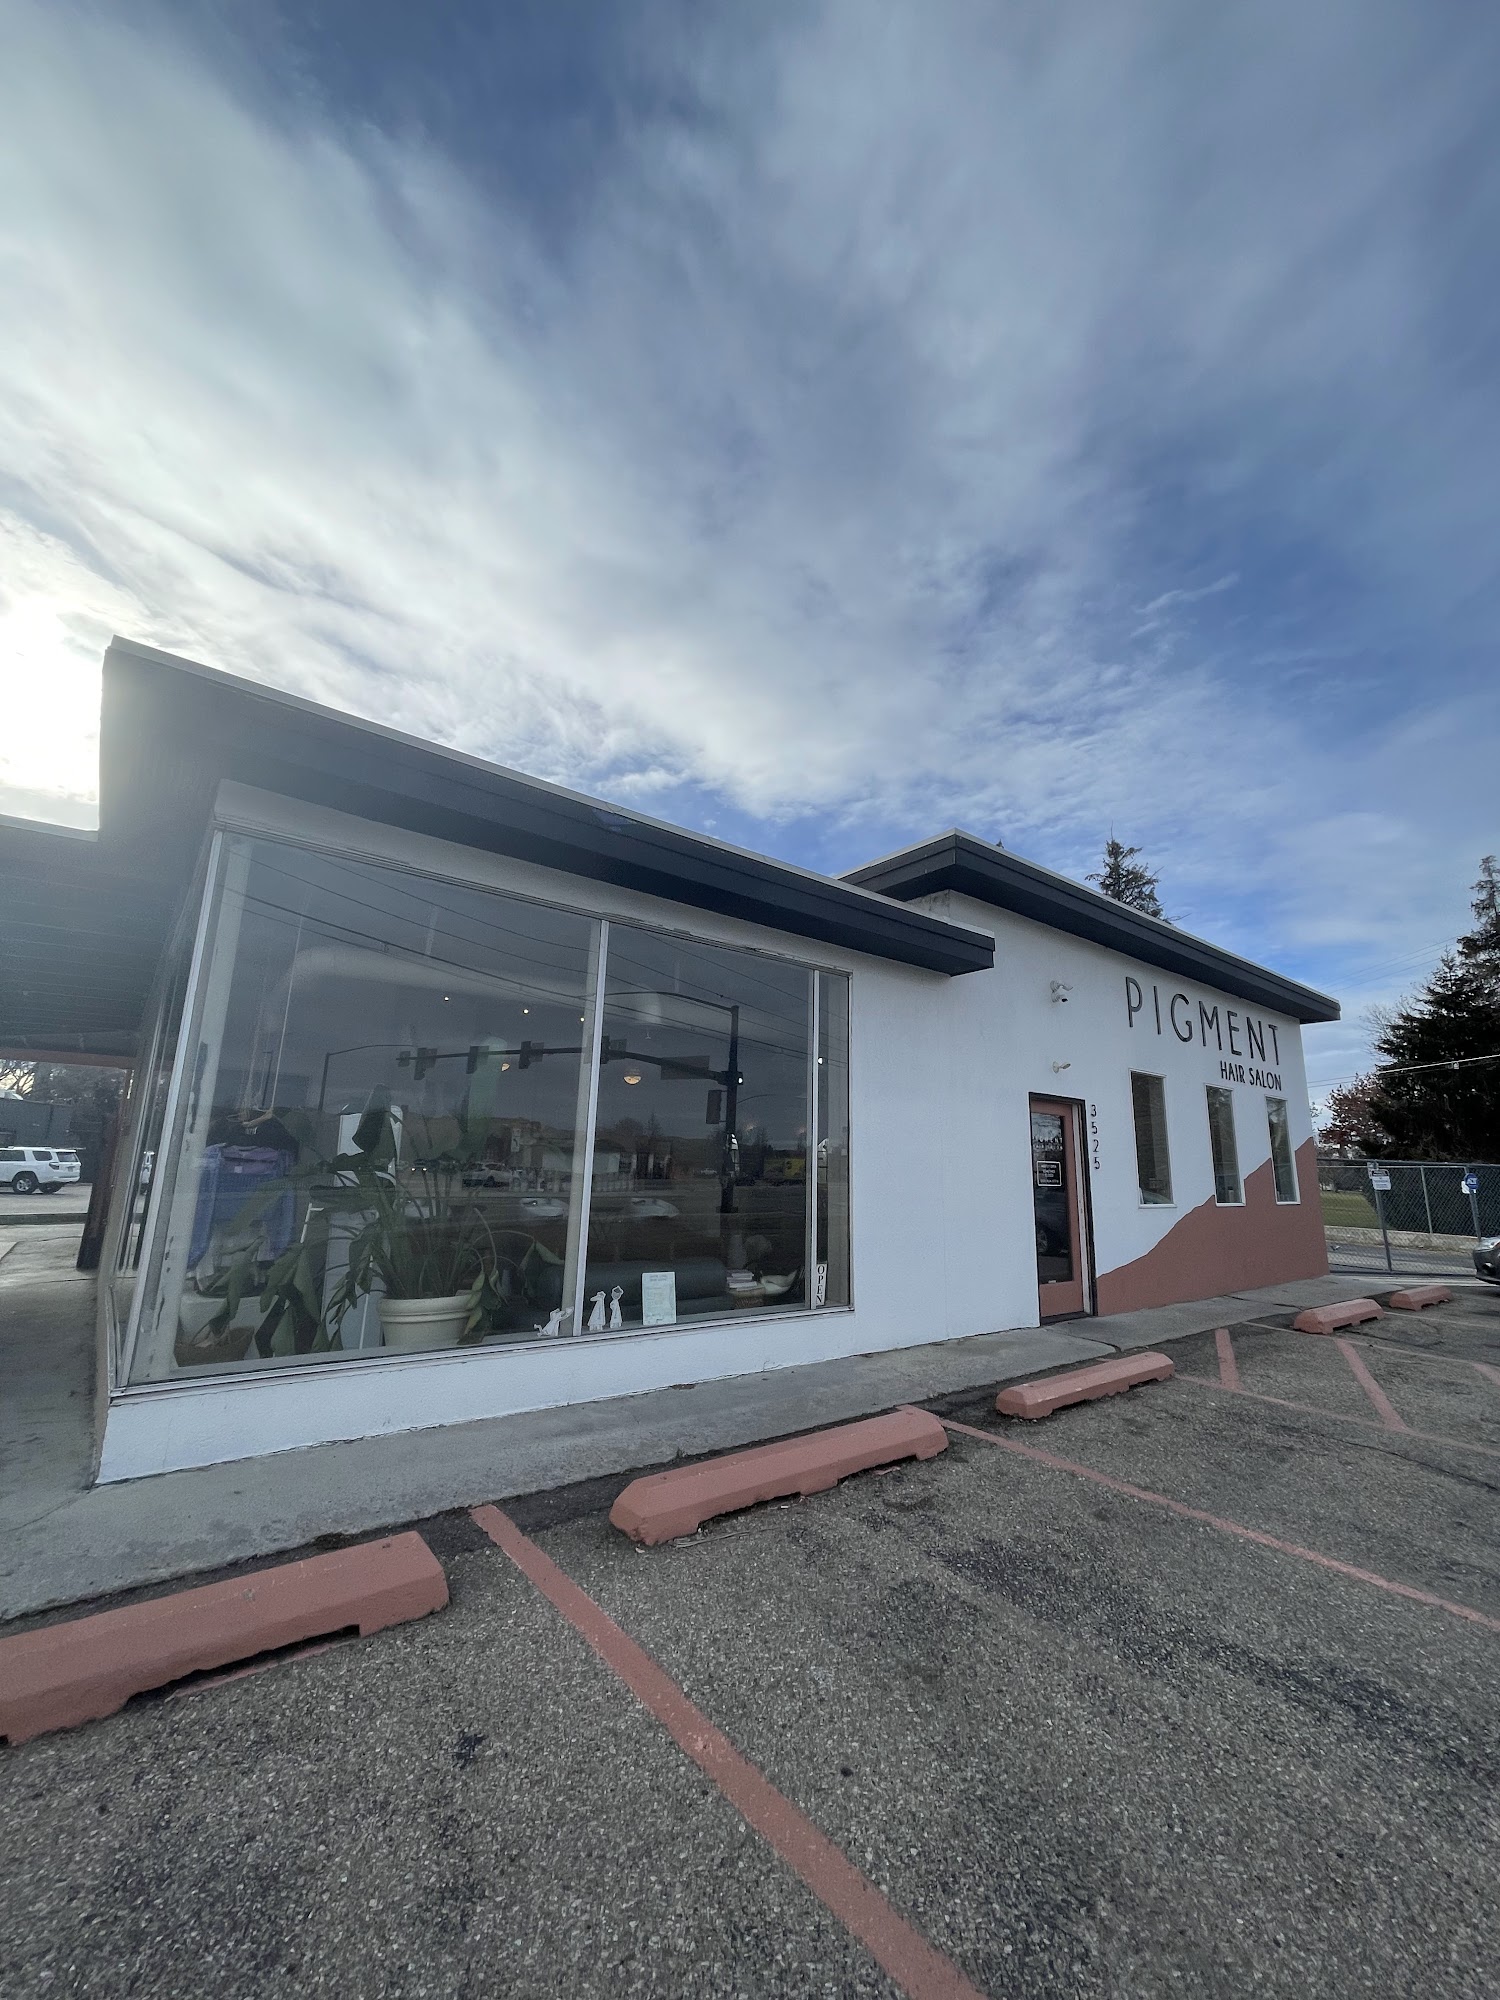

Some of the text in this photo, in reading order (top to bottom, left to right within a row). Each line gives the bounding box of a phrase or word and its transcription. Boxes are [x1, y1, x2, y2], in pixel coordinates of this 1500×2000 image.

[1125, 976, 1279, 1066] PIGMENT
[1219, 1060, 1282, 1092] HAIR SALON
[1090, 1104, 1101, 1170] 3525
[816, 1265, 825, 1303] OPEN
